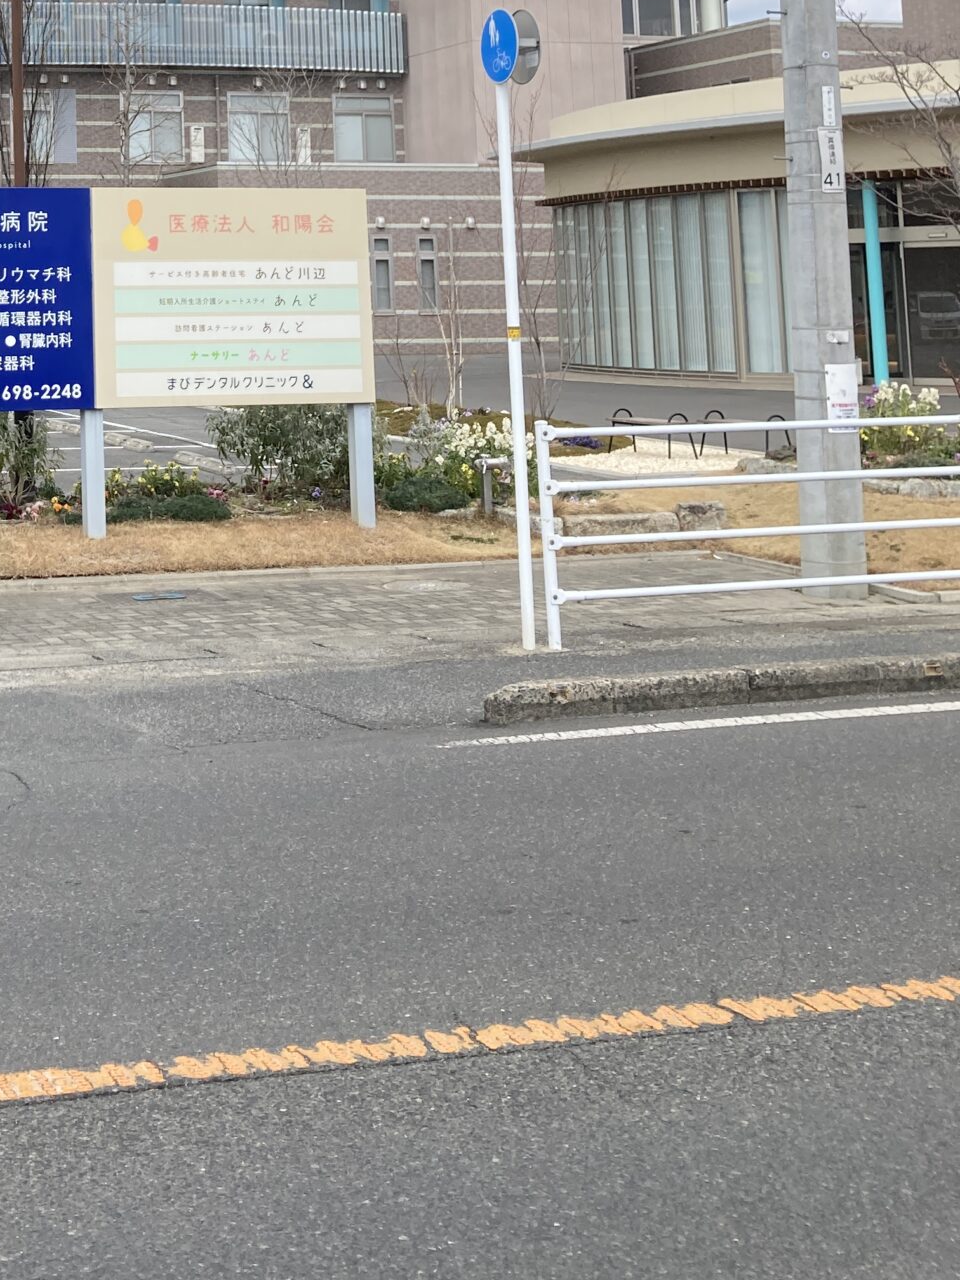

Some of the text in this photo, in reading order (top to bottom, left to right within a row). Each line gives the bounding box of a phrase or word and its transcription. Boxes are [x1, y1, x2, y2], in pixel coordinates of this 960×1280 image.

[824, 172, 841, 187] 41
[168, 213, 336, 234] 医療法人 和陽会
[255, 266, 326, 280] あんど川辺
[274, 293, 317, 307] あんど
[262, 321, 304, 334] あんど
[19, 332, 73, 349] 腎臓内科
[190, 348, 290, 362] ナーサリー あんど
[167, 374, 314, 391] まびデンタルクリニック &
